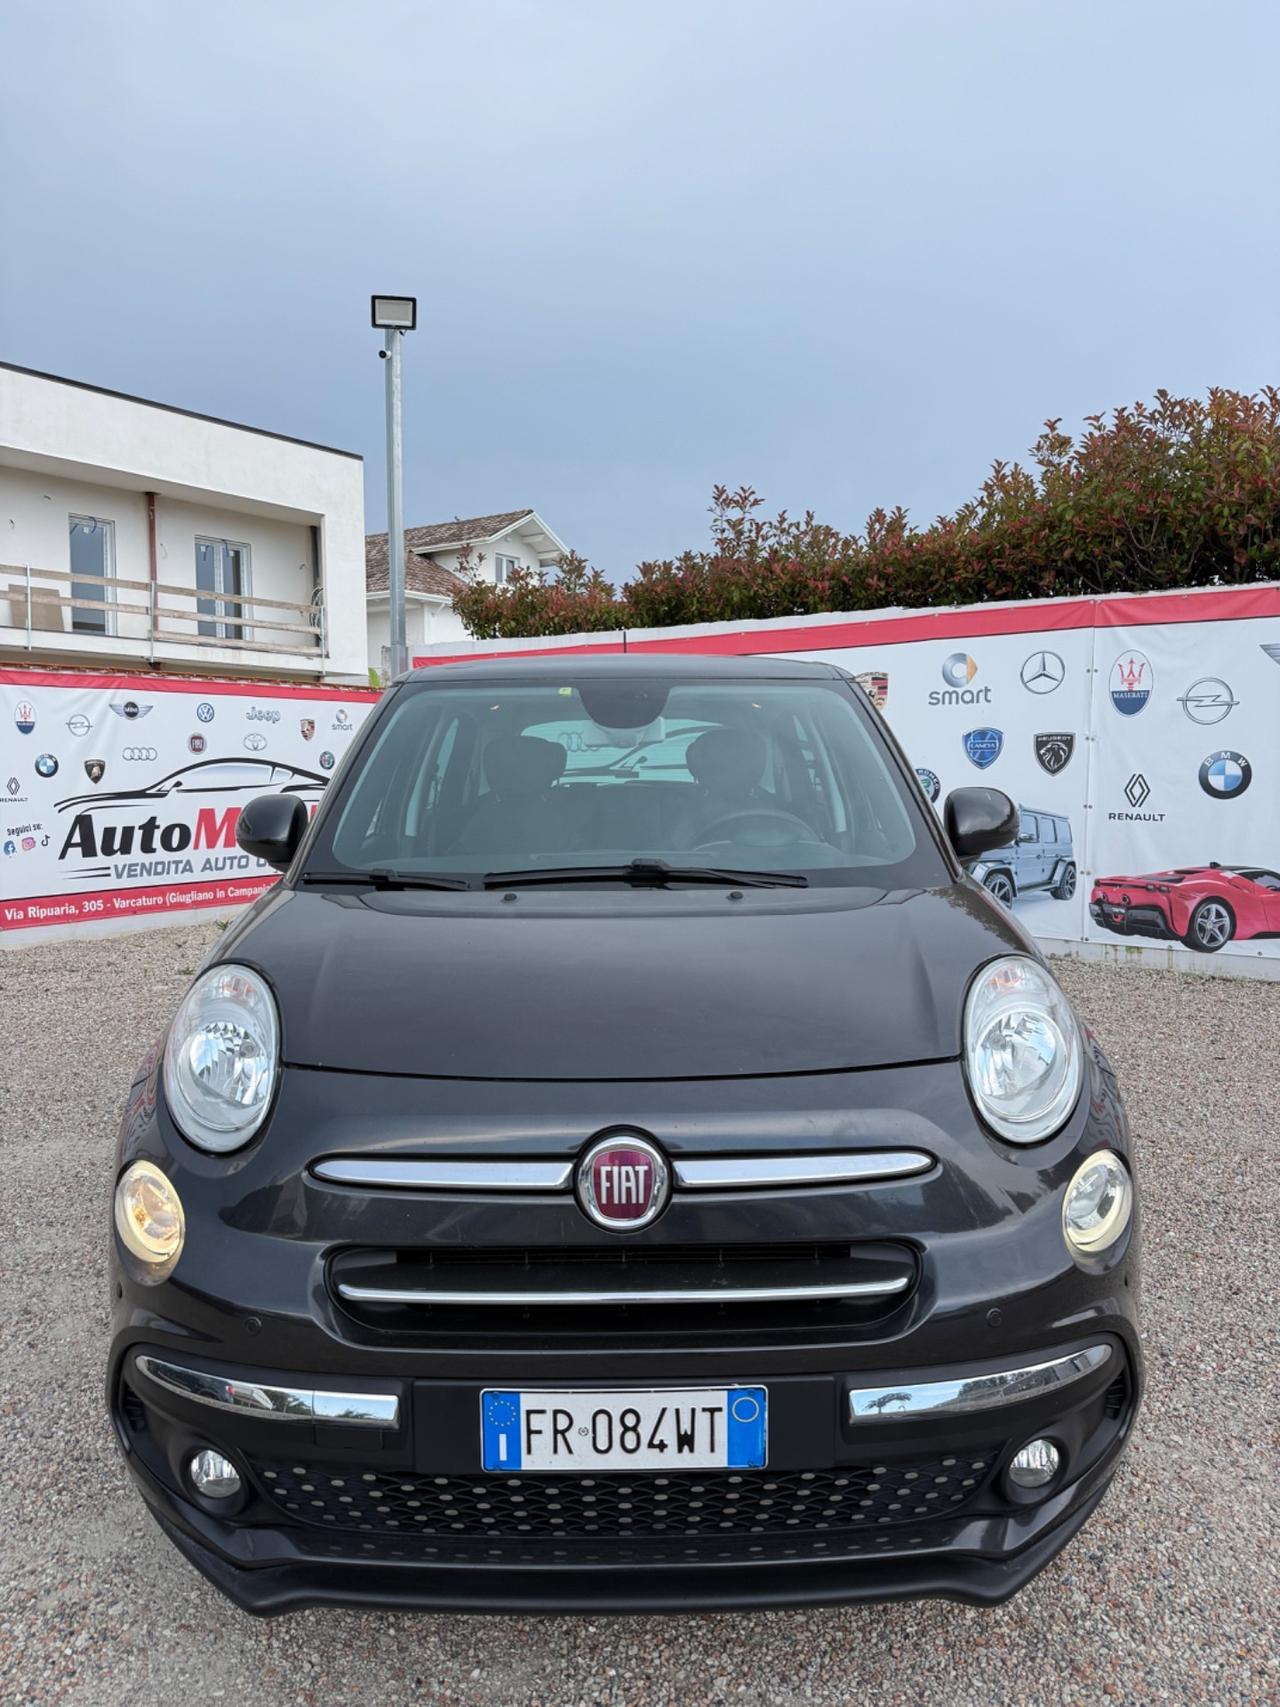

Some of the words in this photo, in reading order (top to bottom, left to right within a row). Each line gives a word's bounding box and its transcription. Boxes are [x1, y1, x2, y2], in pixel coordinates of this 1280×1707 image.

[928, 686, 992, 706] smart
[1113, 690, 1149, 699] MASERATI
[246, 706, 281, 724] Jeep
[331, 723, 353, 731] smart
[1204, 751, 1248, 768] BMW
[1108, 812, 1166, 822] RENAULT
[58, 807, 242, 860] AutoM
[114, 860, 193, 879] VENDITA
[201, 855, 249, 872] AUTO
[5, 908, 24, 920] Via
[28, 903, 79, 919] Ripuaria,
[82, 900, 104, 912] 305
[113, 897, 163, 909] Varcaturo
[166, 891, 214, 905] (Giugliano
[227, 882, 273, 897] Campania
[600, 1165, 648, 1204] FIAT
